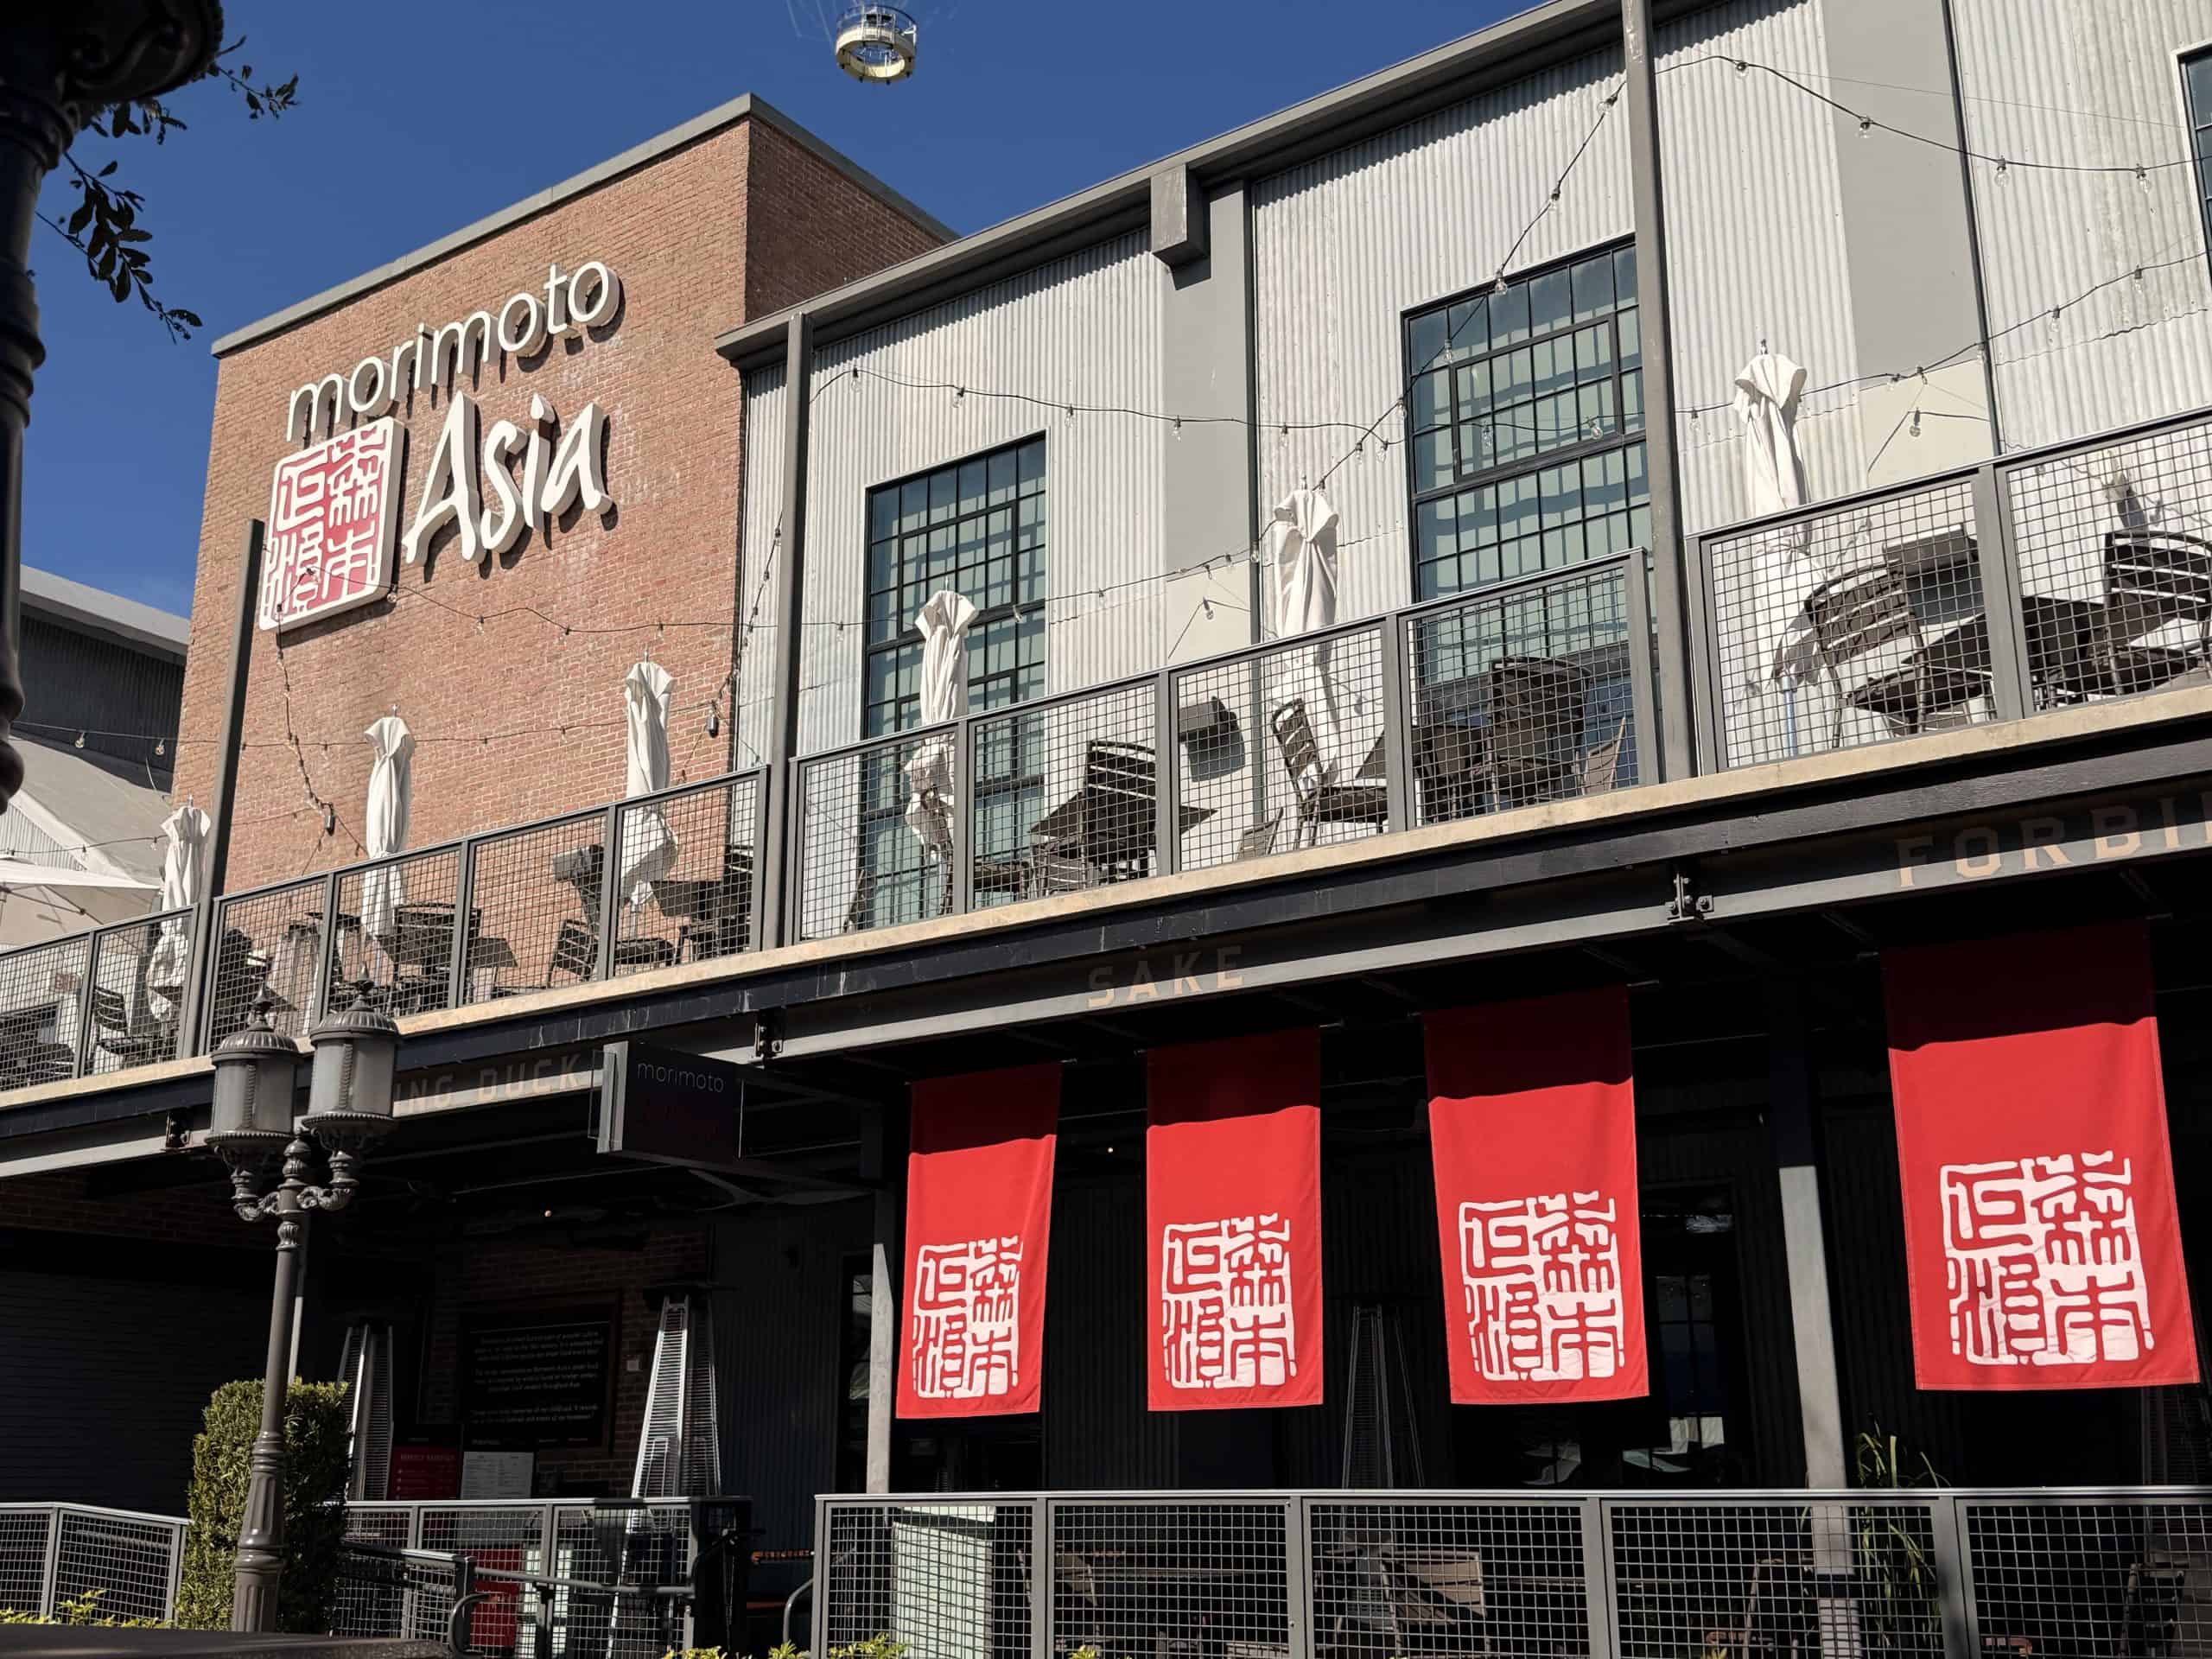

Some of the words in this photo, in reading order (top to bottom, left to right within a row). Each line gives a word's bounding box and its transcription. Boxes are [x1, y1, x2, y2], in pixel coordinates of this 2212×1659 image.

[287, 261, 615, 442] morimoto
[403, 391, 610, 564] Asia
[1895, 790, 2212, 888] FORBI
[1087, 945, 1244, 1009] SAKE
[478, 1052, 582, 1102] DUCK
[637, 1061, 726, 1093] morimoto
